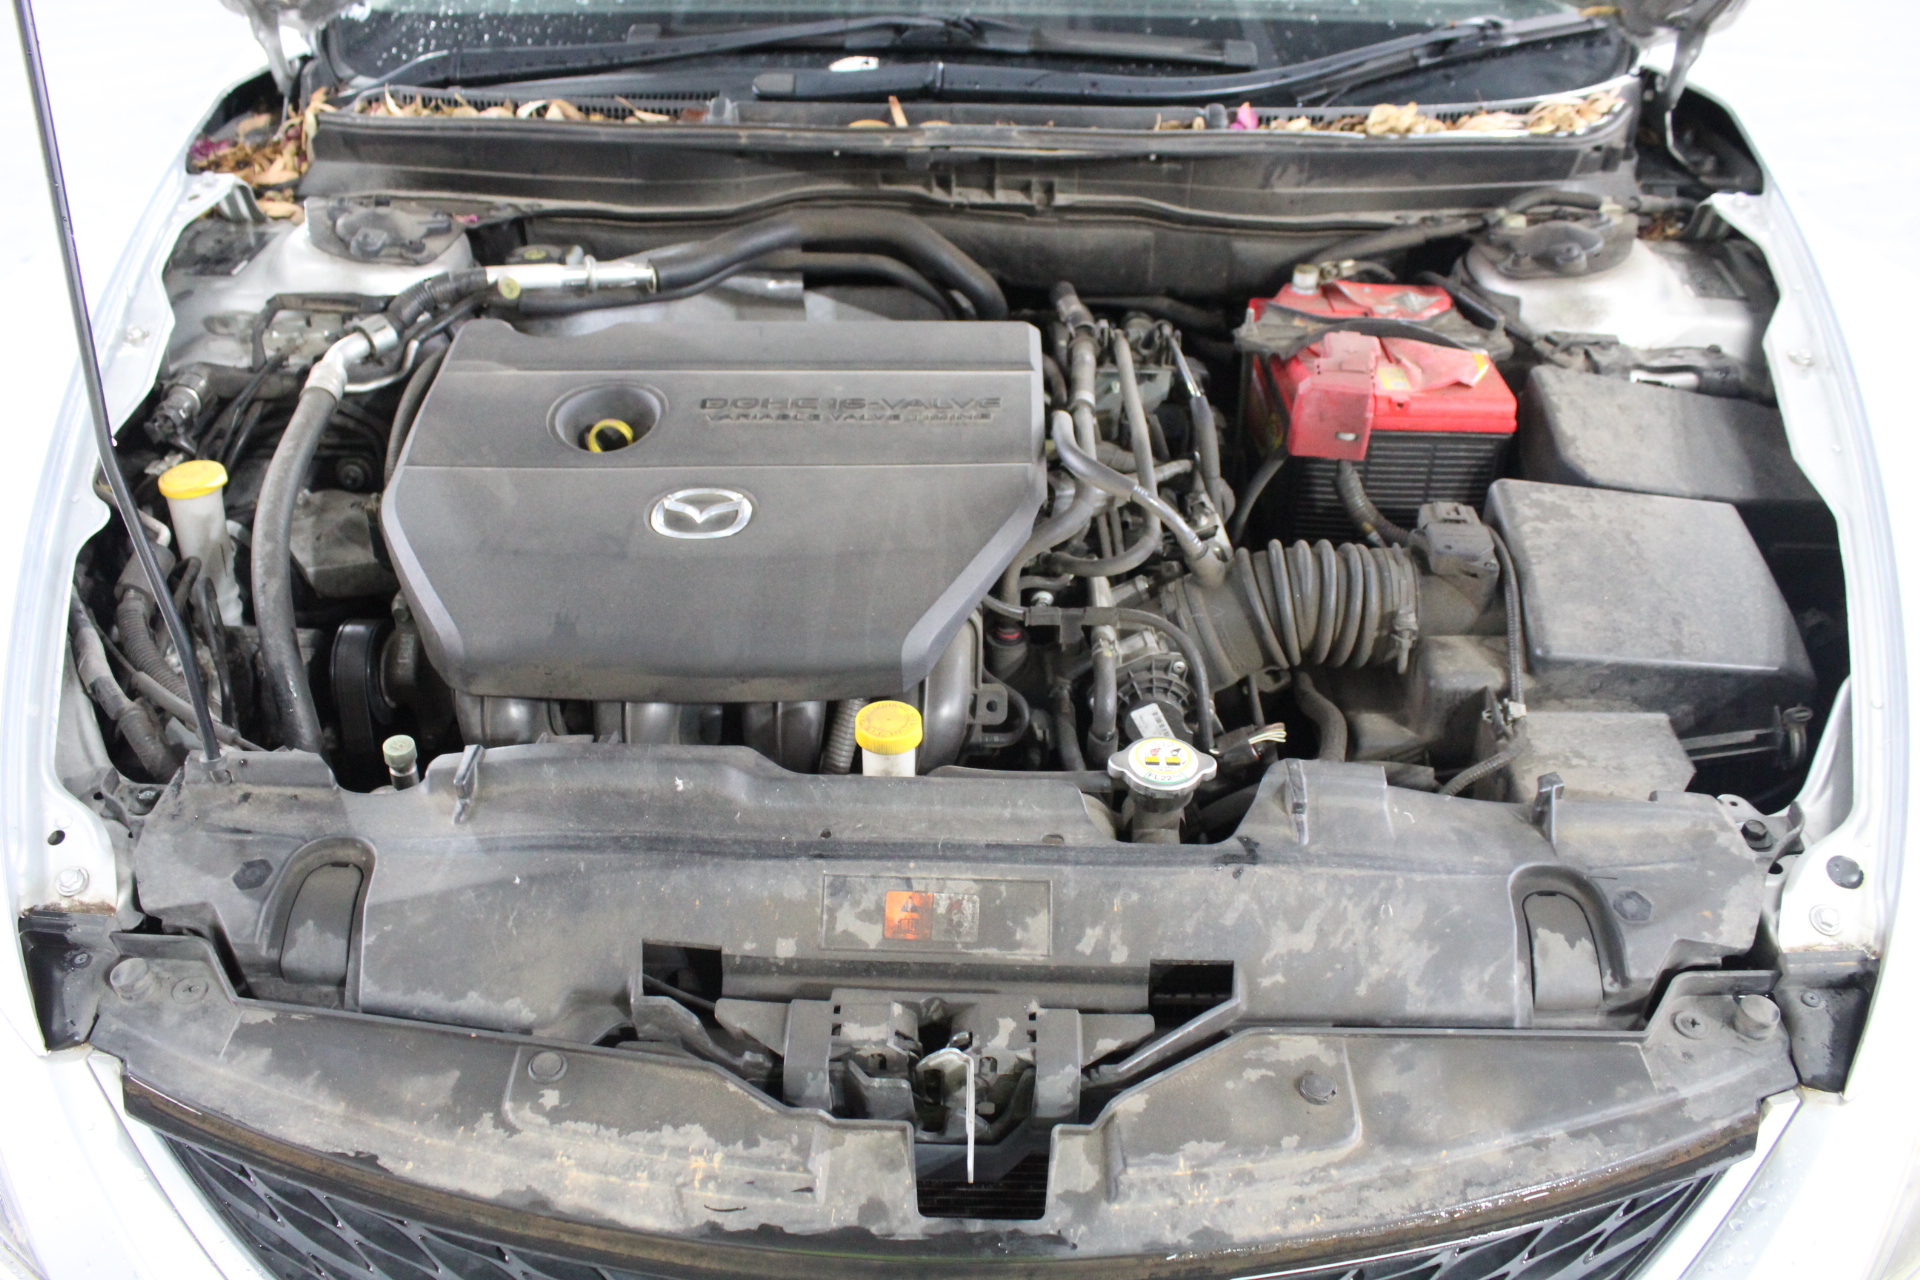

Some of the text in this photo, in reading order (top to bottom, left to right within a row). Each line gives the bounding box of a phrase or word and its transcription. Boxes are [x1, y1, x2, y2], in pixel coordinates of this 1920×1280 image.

[700, 397, 819, 410] DOHC
[706, 413, 821, 422] VARIABLE
[830, 413, 901, 422] VALVE
